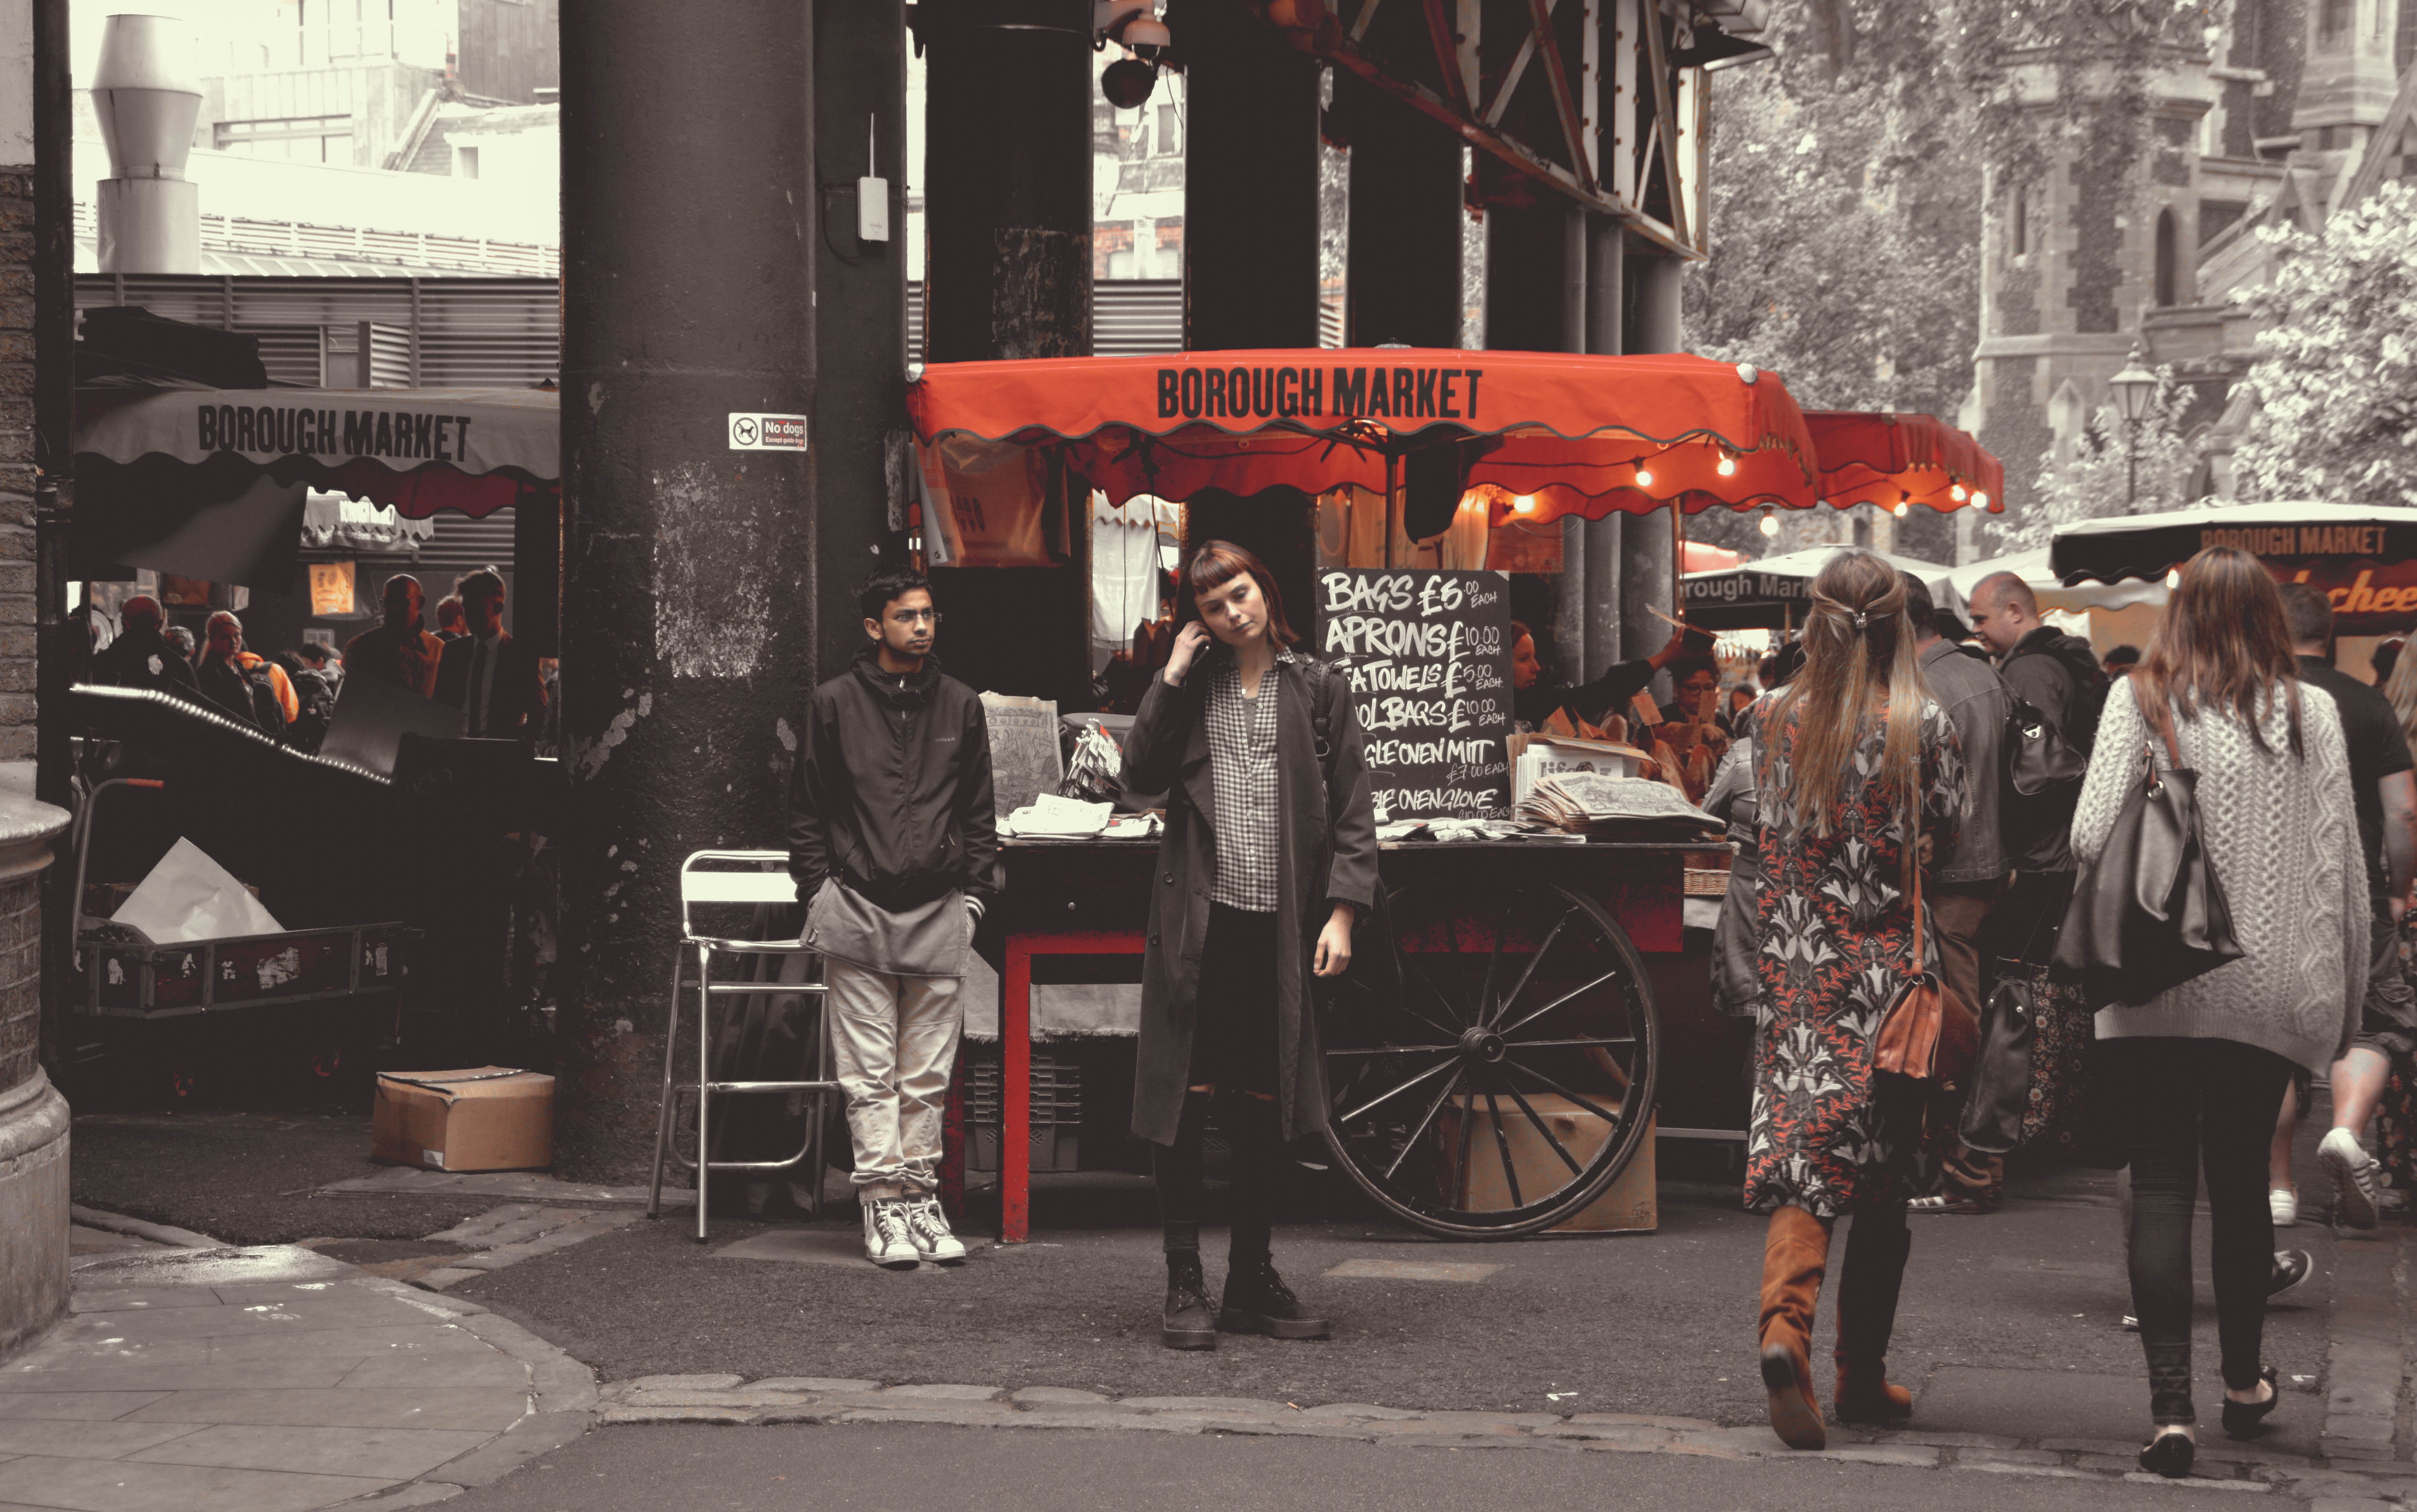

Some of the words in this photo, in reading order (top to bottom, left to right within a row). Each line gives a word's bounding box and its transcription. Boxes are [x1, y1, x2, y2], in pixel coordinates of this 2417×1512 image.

[1157, 367, 1322, 418] BOROUGH
[1333, 367, 1482, 419] MARKET
[198, 405, 336, 455] BOROUGH
[343, 411, 470, 461] MARKET
[766, 421, 780, 433] No
[783, 422, 803, 437] dogs
[2201, 528, 2296, 555] BOROUGH
[2300, 527, 2386, 555] MARKET
[1322, 572, 1413, 613] BAGS
[1471, 591, 1497, 608] EACH
[1679, 573, 1752, 601] rough
[1325, 616, 1447, 657] APRONS
[1479, 712, 1505, 726] EACH
[1399, 737, 1444, 764] OVEN
[1446, 763, 1483, 786] £7.00
[1485, 761, 1510, 776] EACH
